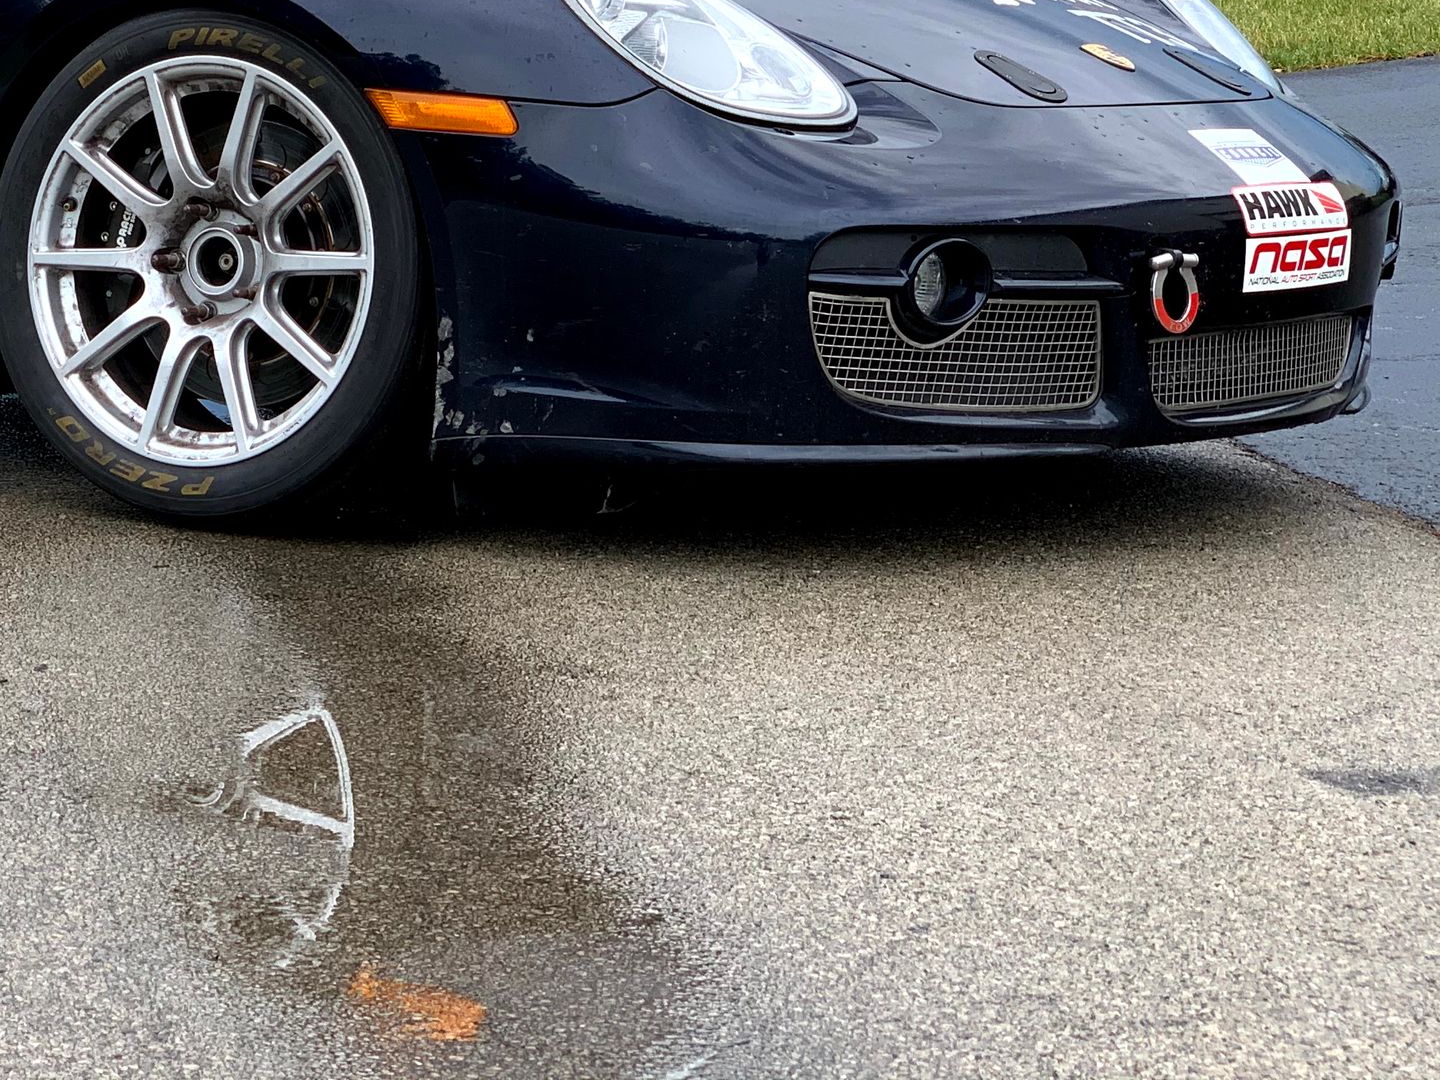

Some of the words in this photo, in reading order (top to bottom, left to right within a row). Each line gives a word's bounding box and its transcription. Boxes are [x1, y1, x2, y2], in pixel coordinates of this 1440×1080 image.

[167, 27, 328, 90] PIRELLI
[1239, 188, 1319, 220] HAWK
[1250, 217, 1347, 230] PERFORMANCE
[1249, 235, 1348, 275] nasa
[1248, 276, 1280, 286] NATIONAL
[1281, 274, 1298, 284] AUTO
[1298, 272, 1317, 282] SPORT
[1316, 269, 1345, 280] ASSOCIATION
